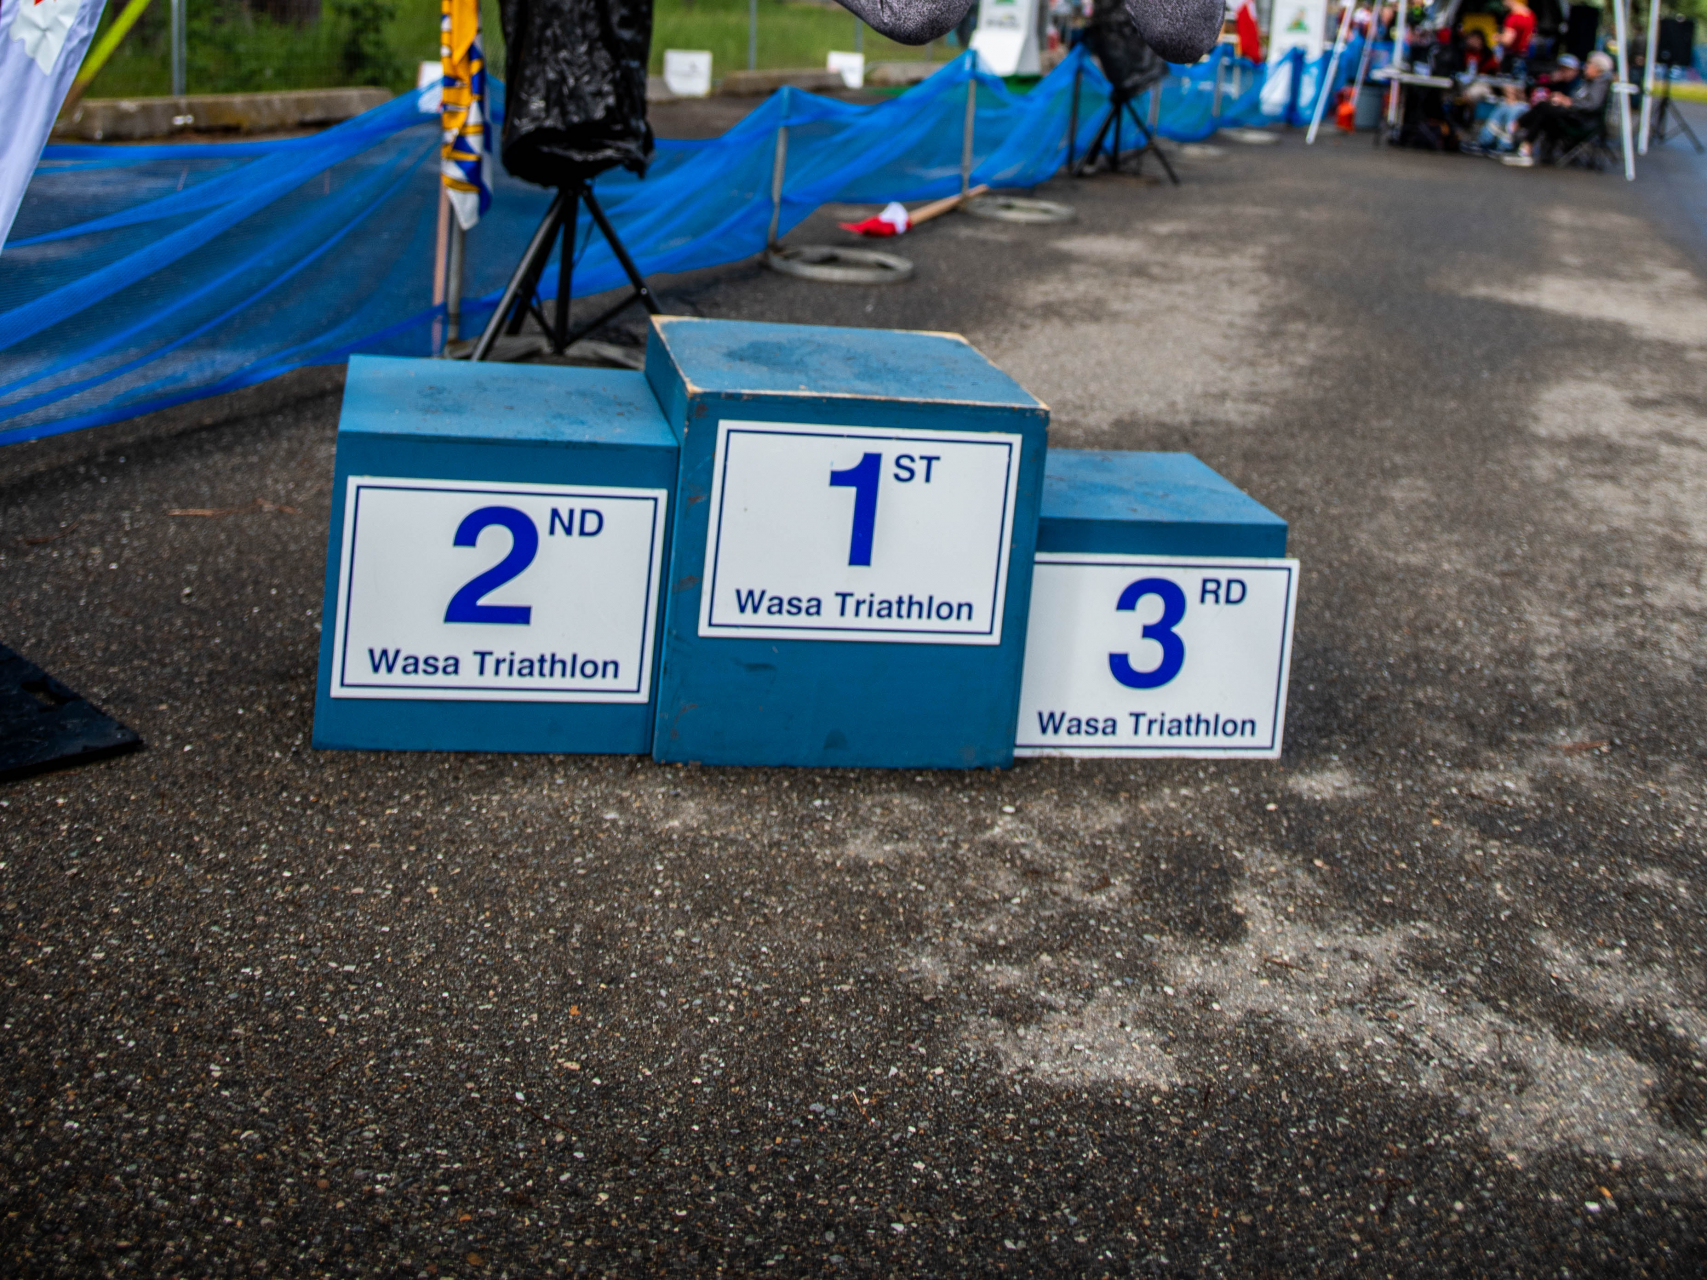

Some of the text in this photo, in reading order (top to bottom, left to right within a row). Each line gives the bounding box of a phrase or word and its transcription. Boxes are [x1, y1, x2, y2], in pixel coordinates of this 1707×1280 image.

[735, 588, 974, 621] Wasa Triathlon
[367, 648, 619, 680] Wasa Triathlon
[1037, 711, 1257, 737] Wasa Triathlon
